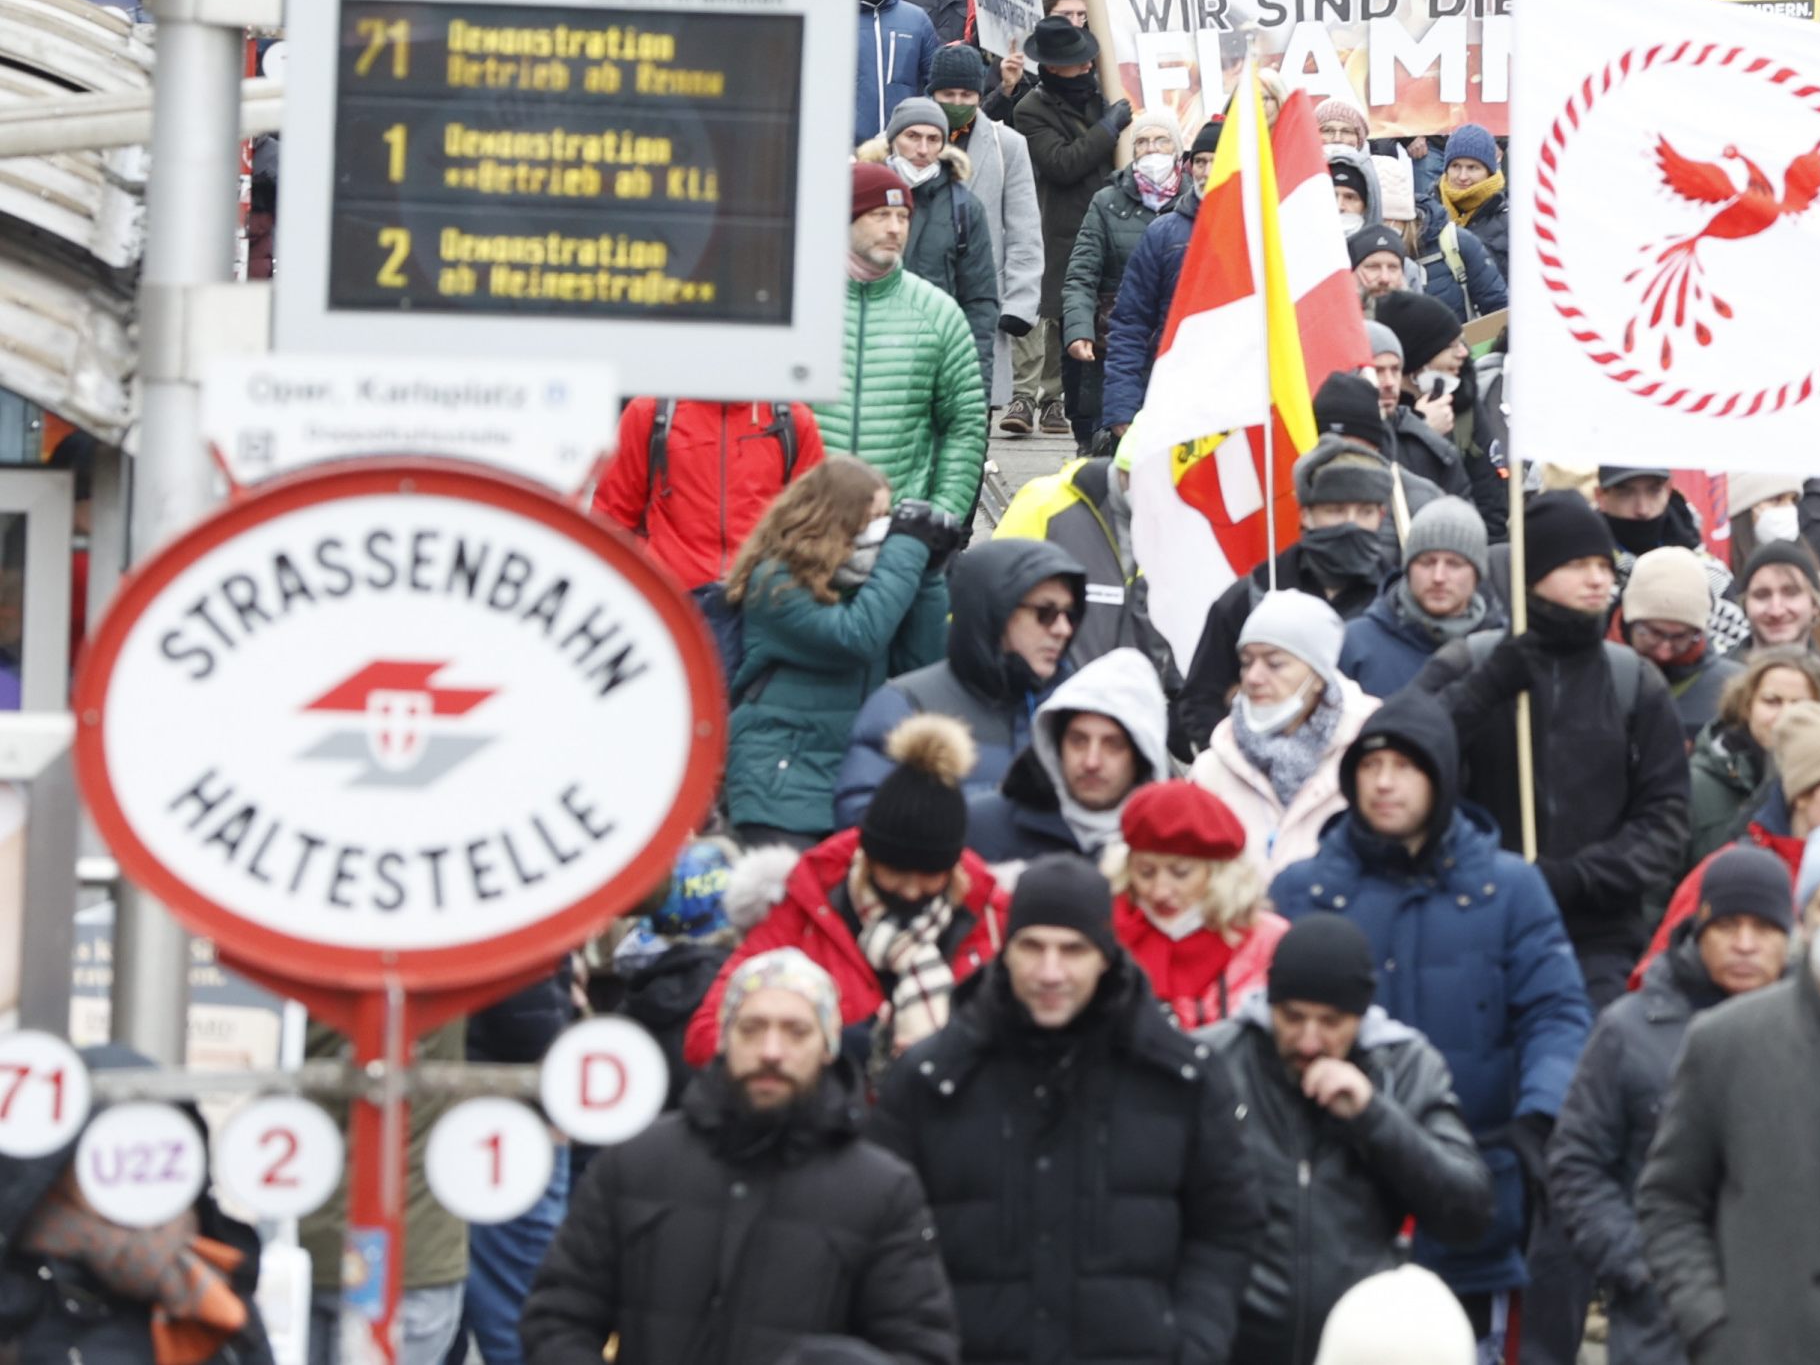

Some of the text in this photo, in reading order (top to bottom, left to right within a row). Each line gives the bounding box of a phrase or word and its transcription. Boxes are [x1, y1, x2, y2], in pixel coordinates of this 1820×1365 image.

[382, 122, 407, 183] 1
[375, 226, 412, 289] 2
[156, 527, 652, 700] STRASSENBAHN
[166, 767, 619, 914] HALTESTELLE
[0, 1062, 67, 1124] 71
[578, 1052, 630, 1114] D
[91, 1138, 189, 1188] U2Z
[257, 1125, 302, 1191] 2
[475, 1126, 508, 1191] 1
